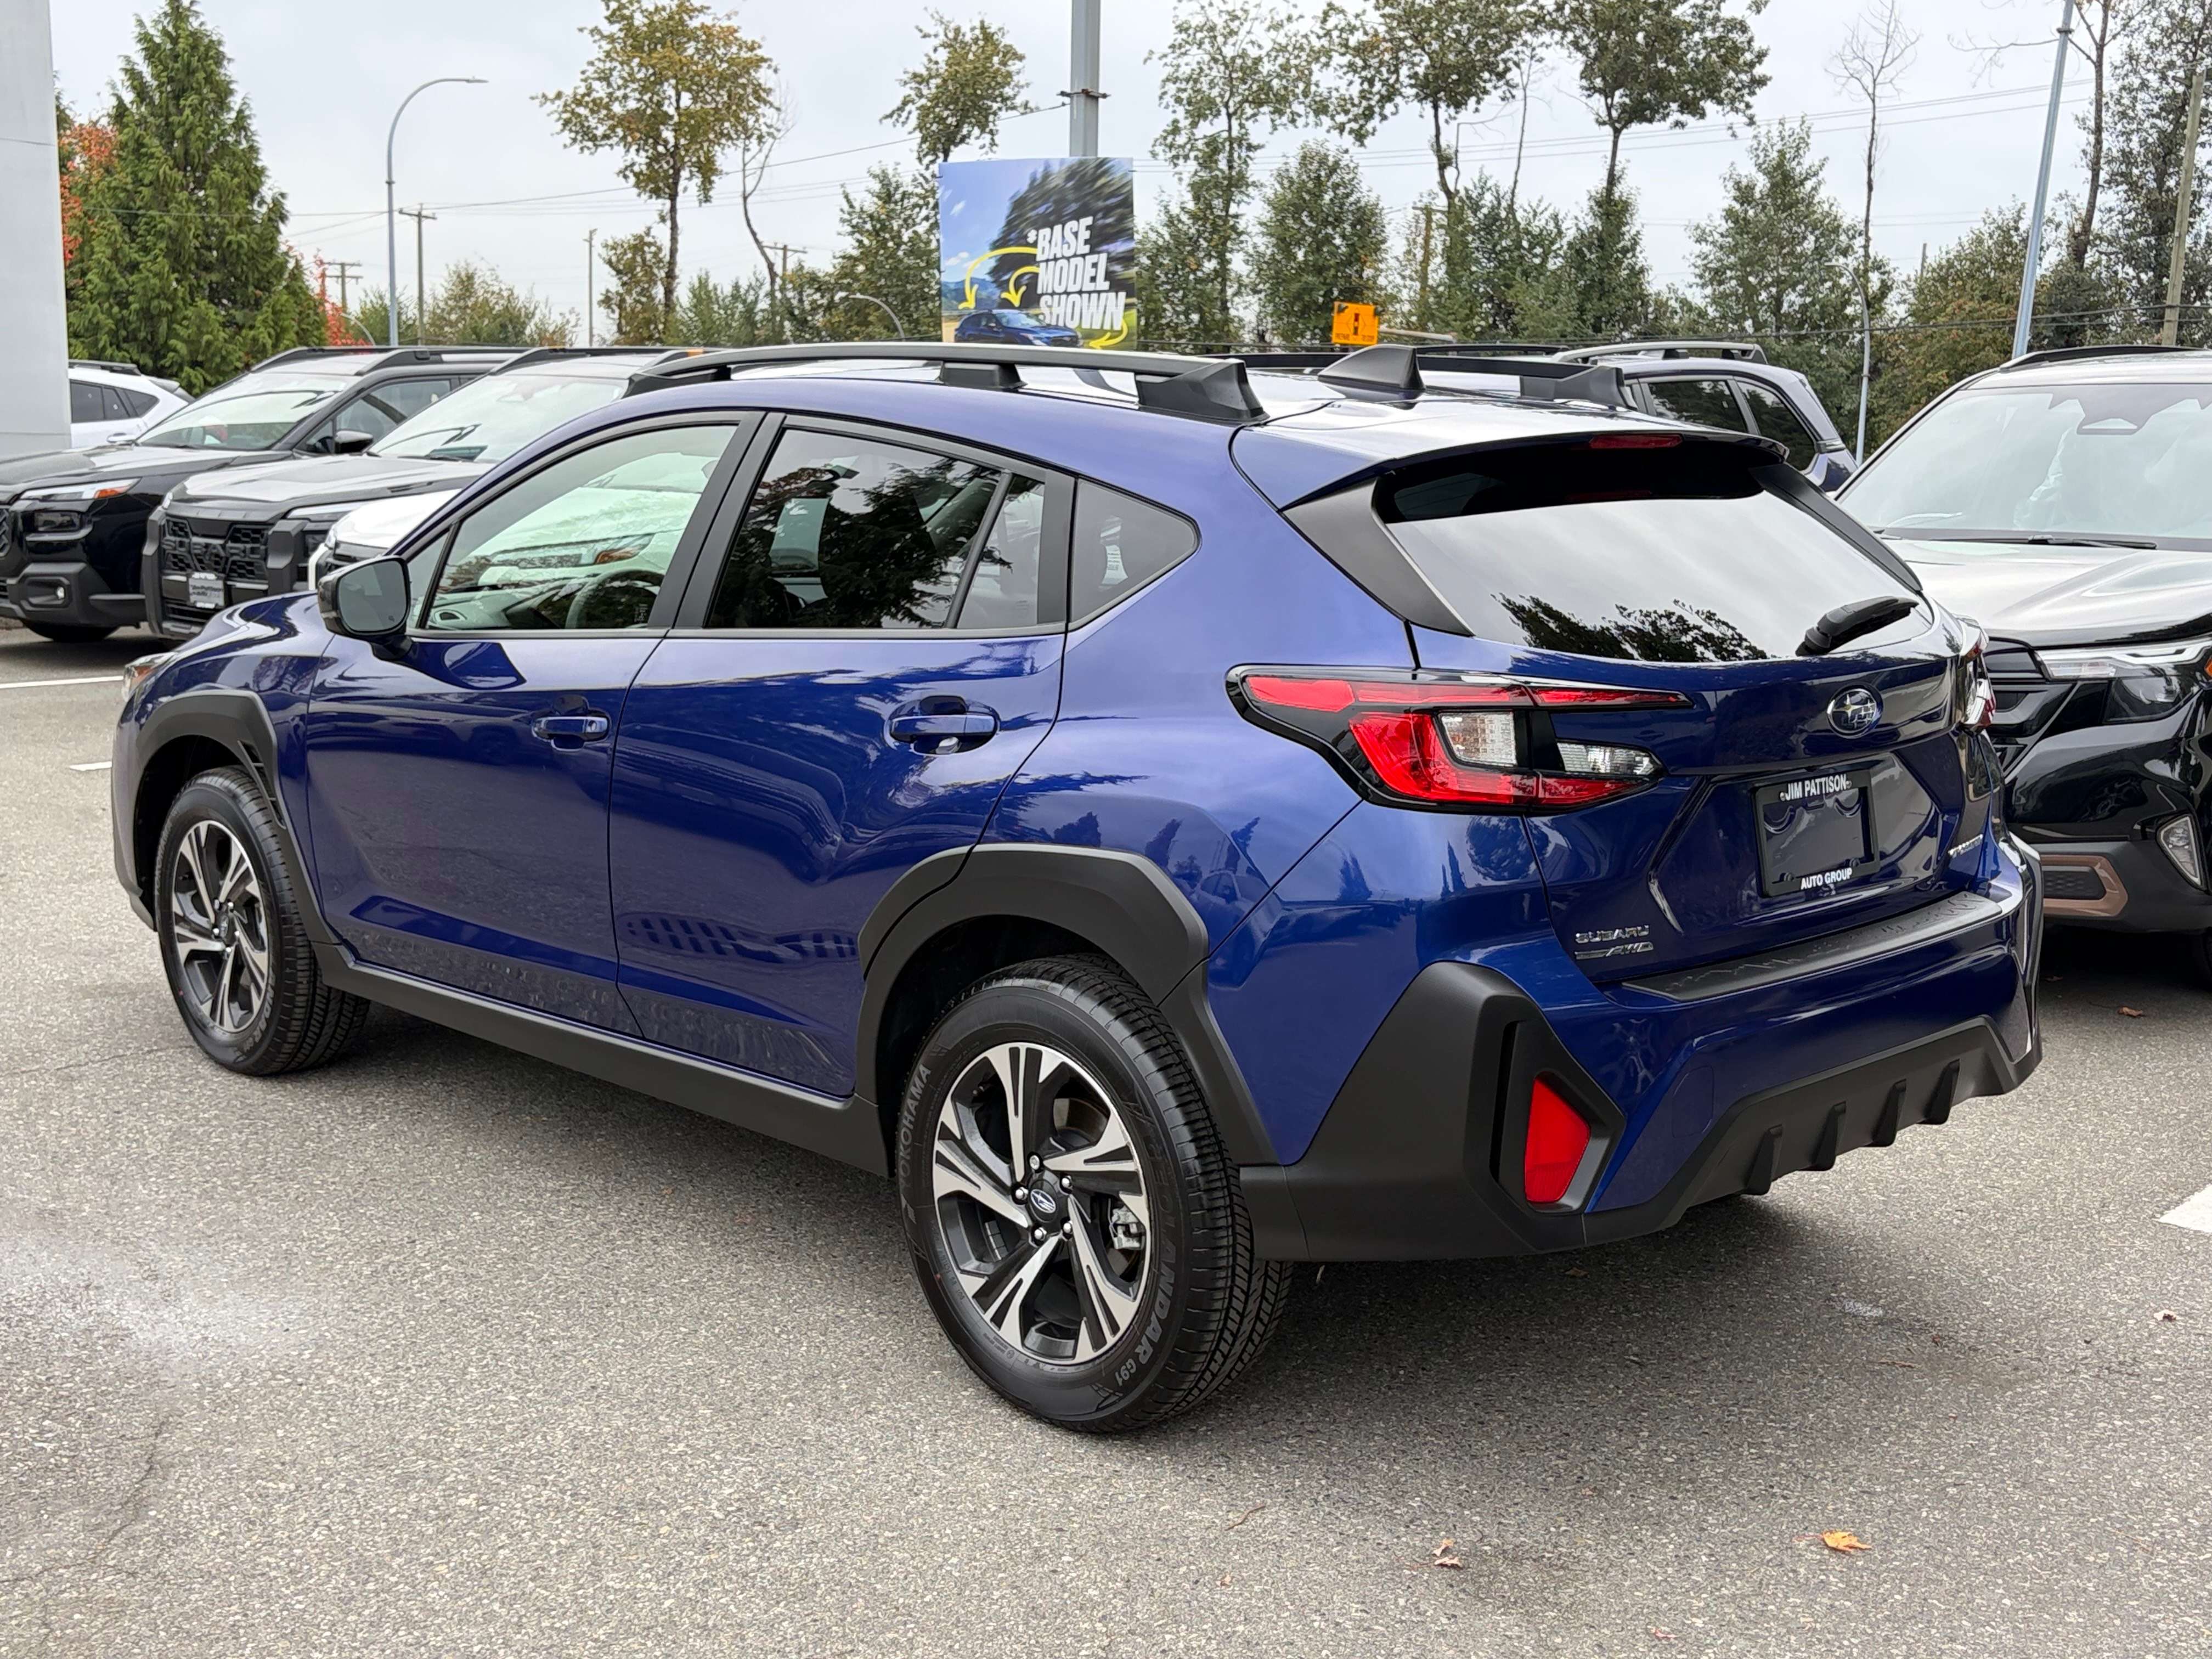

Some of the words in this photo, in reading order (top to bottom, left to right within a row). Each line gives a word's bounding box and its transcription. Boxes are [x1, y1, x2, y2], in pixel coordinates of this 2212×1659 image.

[1036, 253, 1111, 295] MODEL
[1039, 291, 1127, 331] SHOWN
[1786, 780, 1803, 801] JIM
[1804, 774, 1847, 796] PATTISON
[1801, 876, 1823, 890] AUTO
[1825, 867, 1853, 885] GROUP
[1576, 925, 1649, 944] SUBARU
[900, 1064, 932, 1189] YOKOHAMA
[1116, 1358, 1137, 1387] G91
